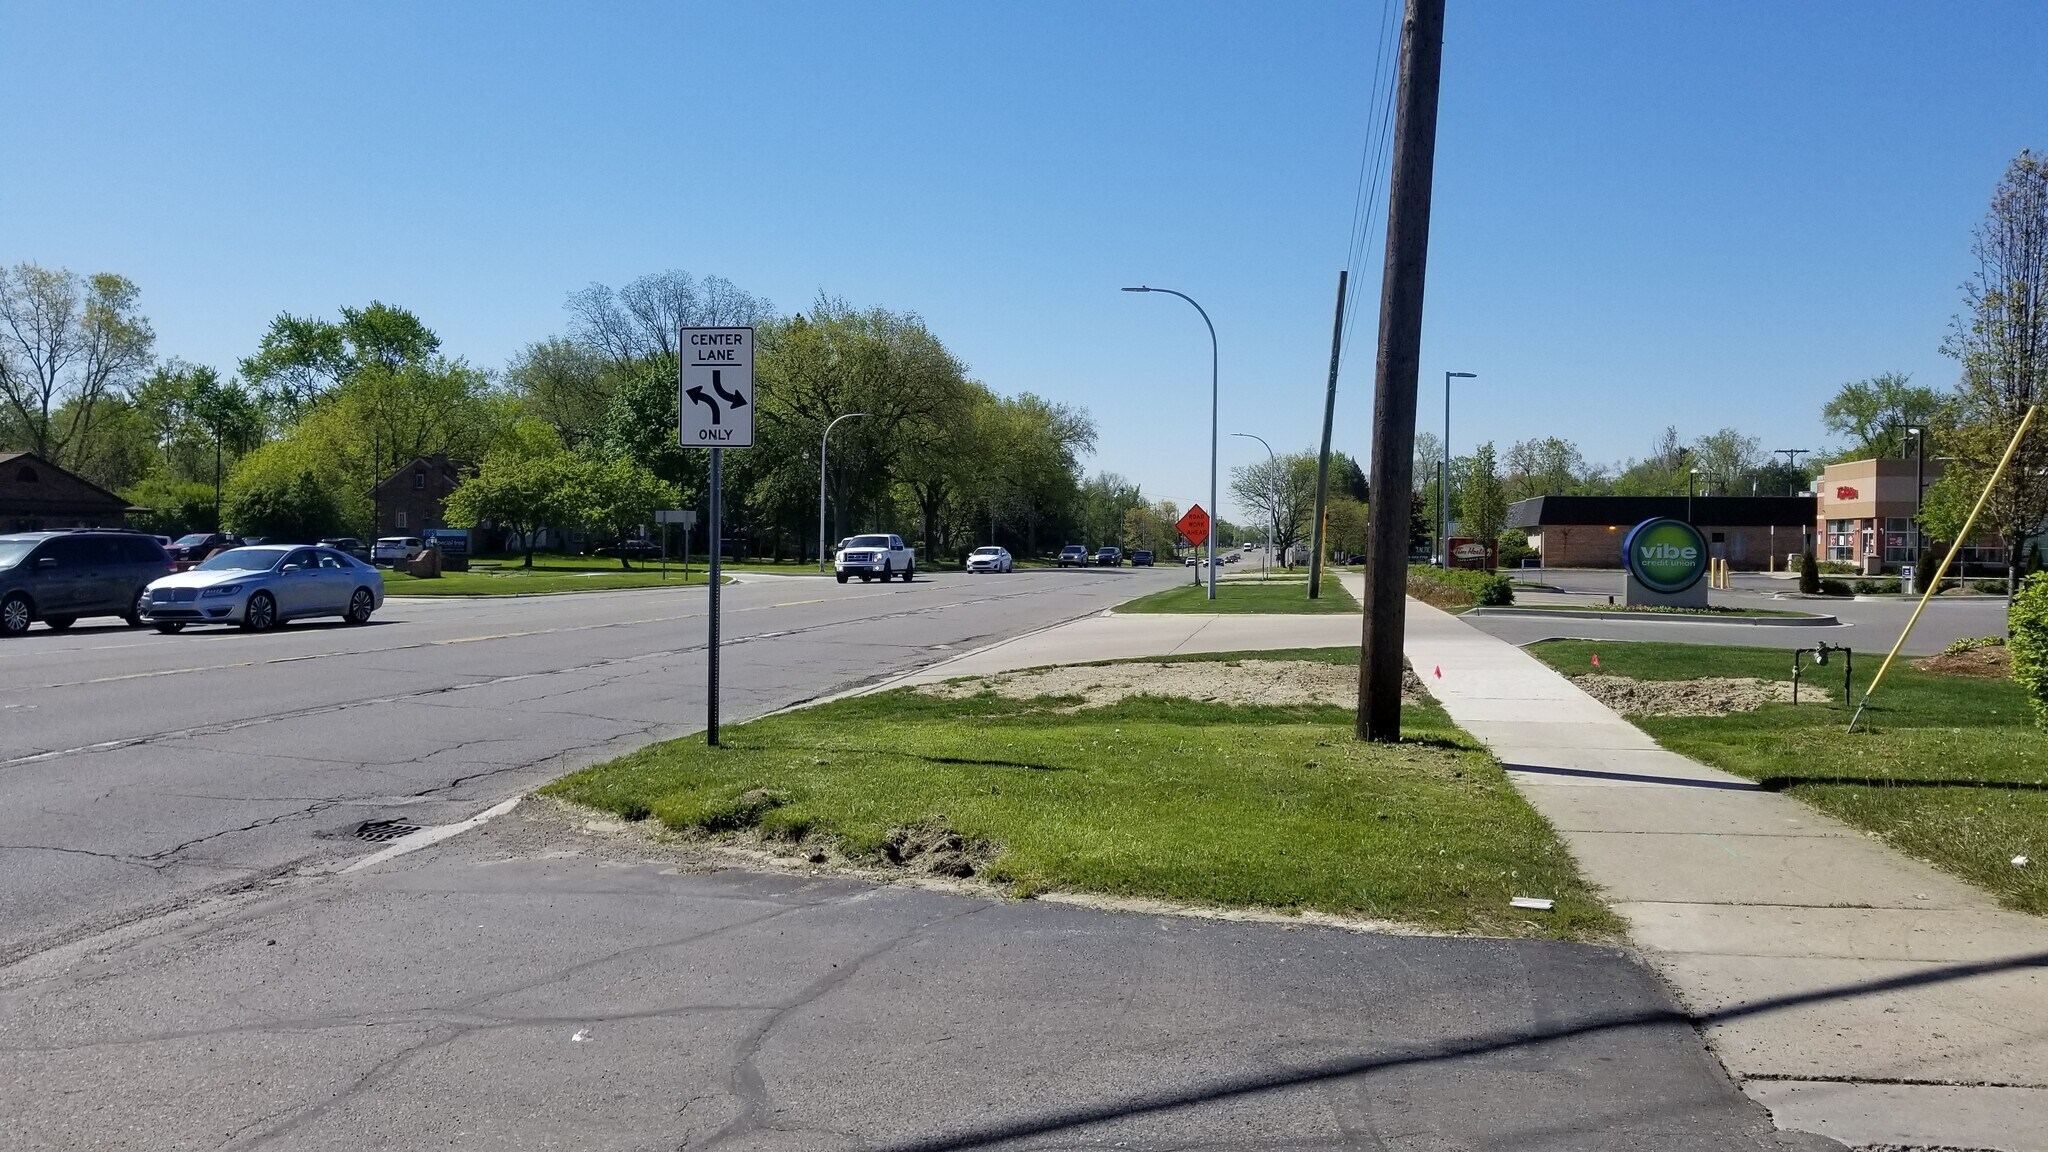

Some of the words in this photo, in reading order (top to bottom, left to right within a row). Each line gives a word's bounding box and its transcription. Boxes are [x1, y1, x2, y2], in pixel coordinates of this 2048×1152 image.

[691, 334, 742, 345] CENTER
[698, 350, 735, 360] LANE
[699, 429, 733, 440] ONLY
[1641, 543, 1697, 559] vibe
